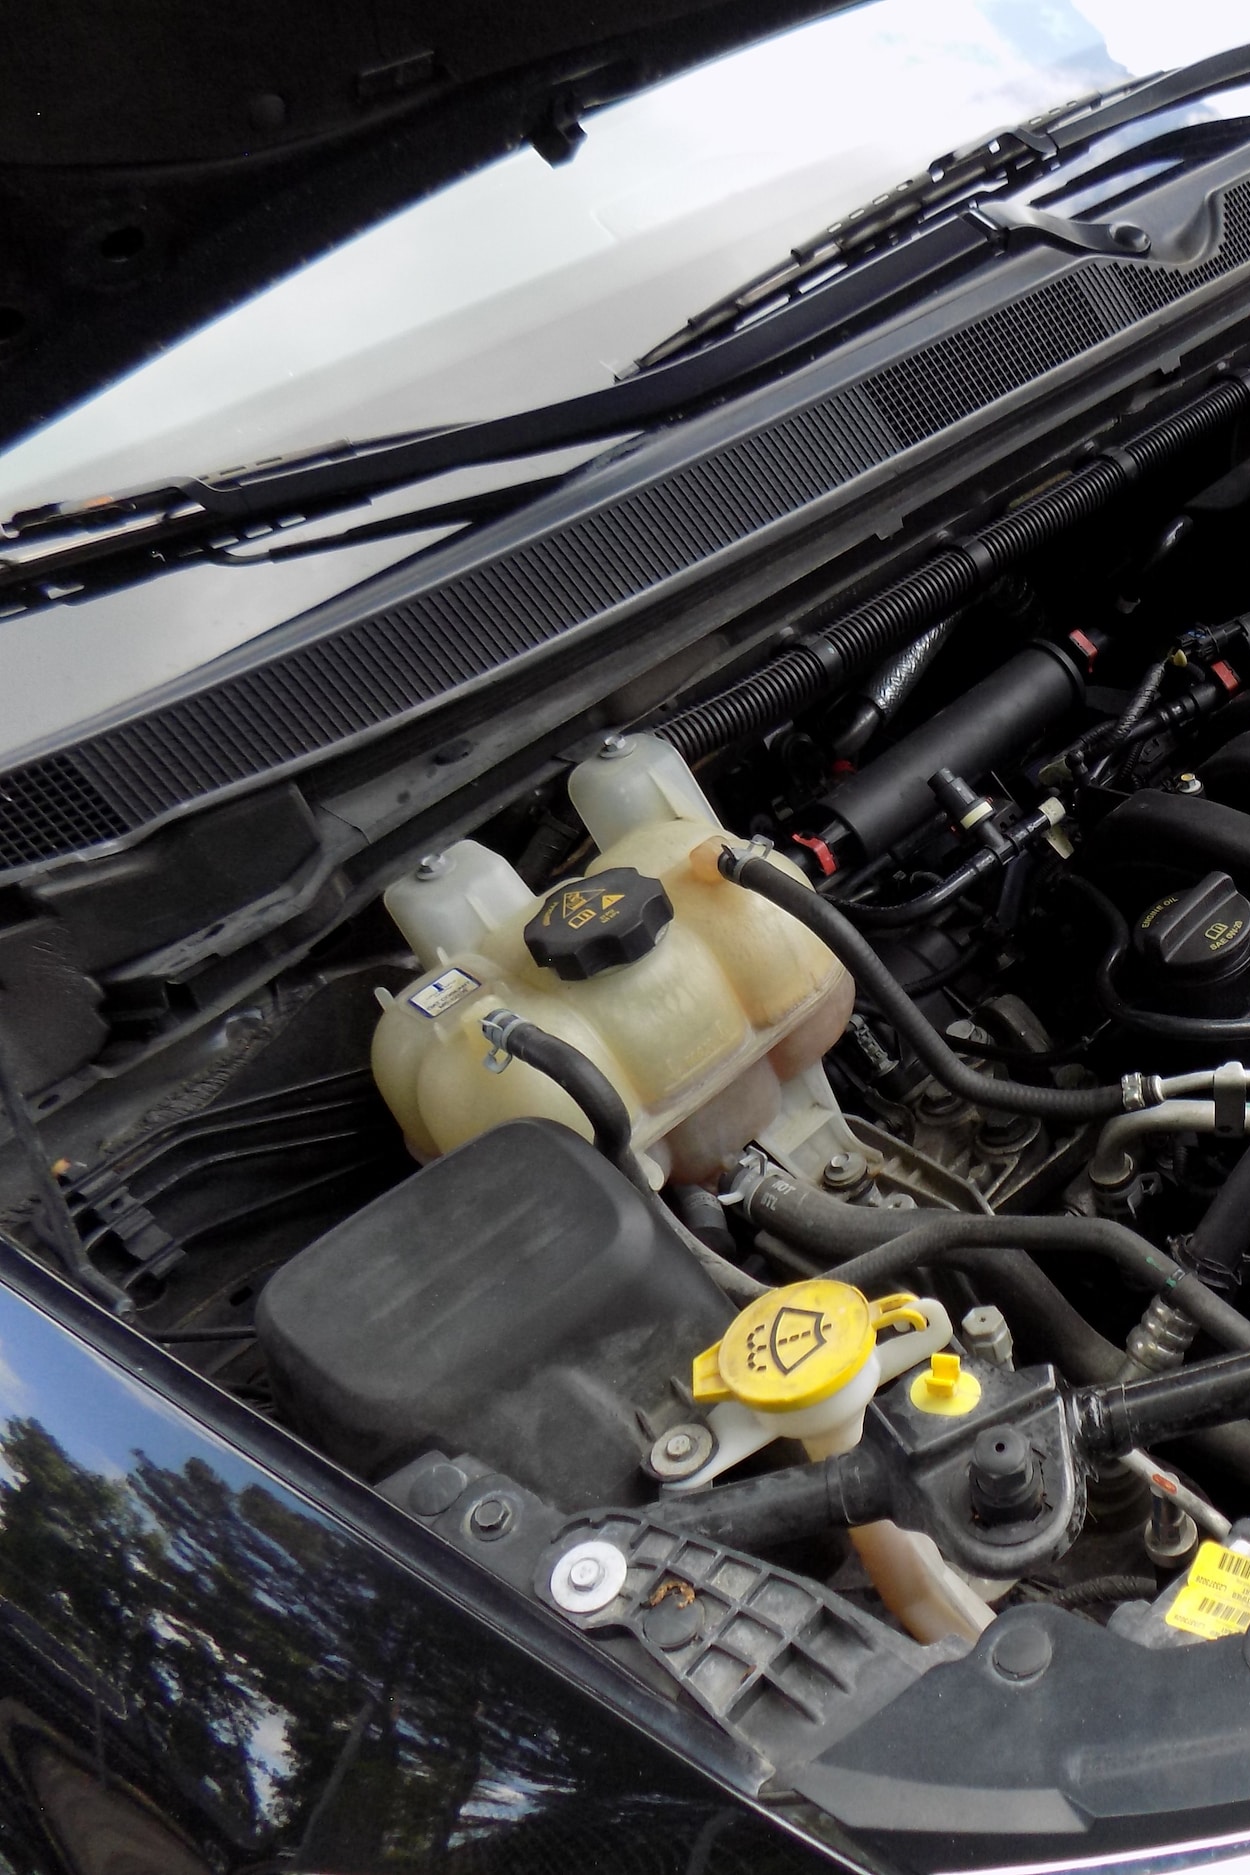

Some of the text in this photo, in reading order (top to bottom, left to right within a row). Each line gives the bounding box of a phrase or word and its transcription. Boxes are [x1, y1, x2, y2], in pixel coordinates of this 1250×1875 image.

[1142, 897, 1179, 929] ENGINE OIL
[1209, 936, 1228, 951] SAE
